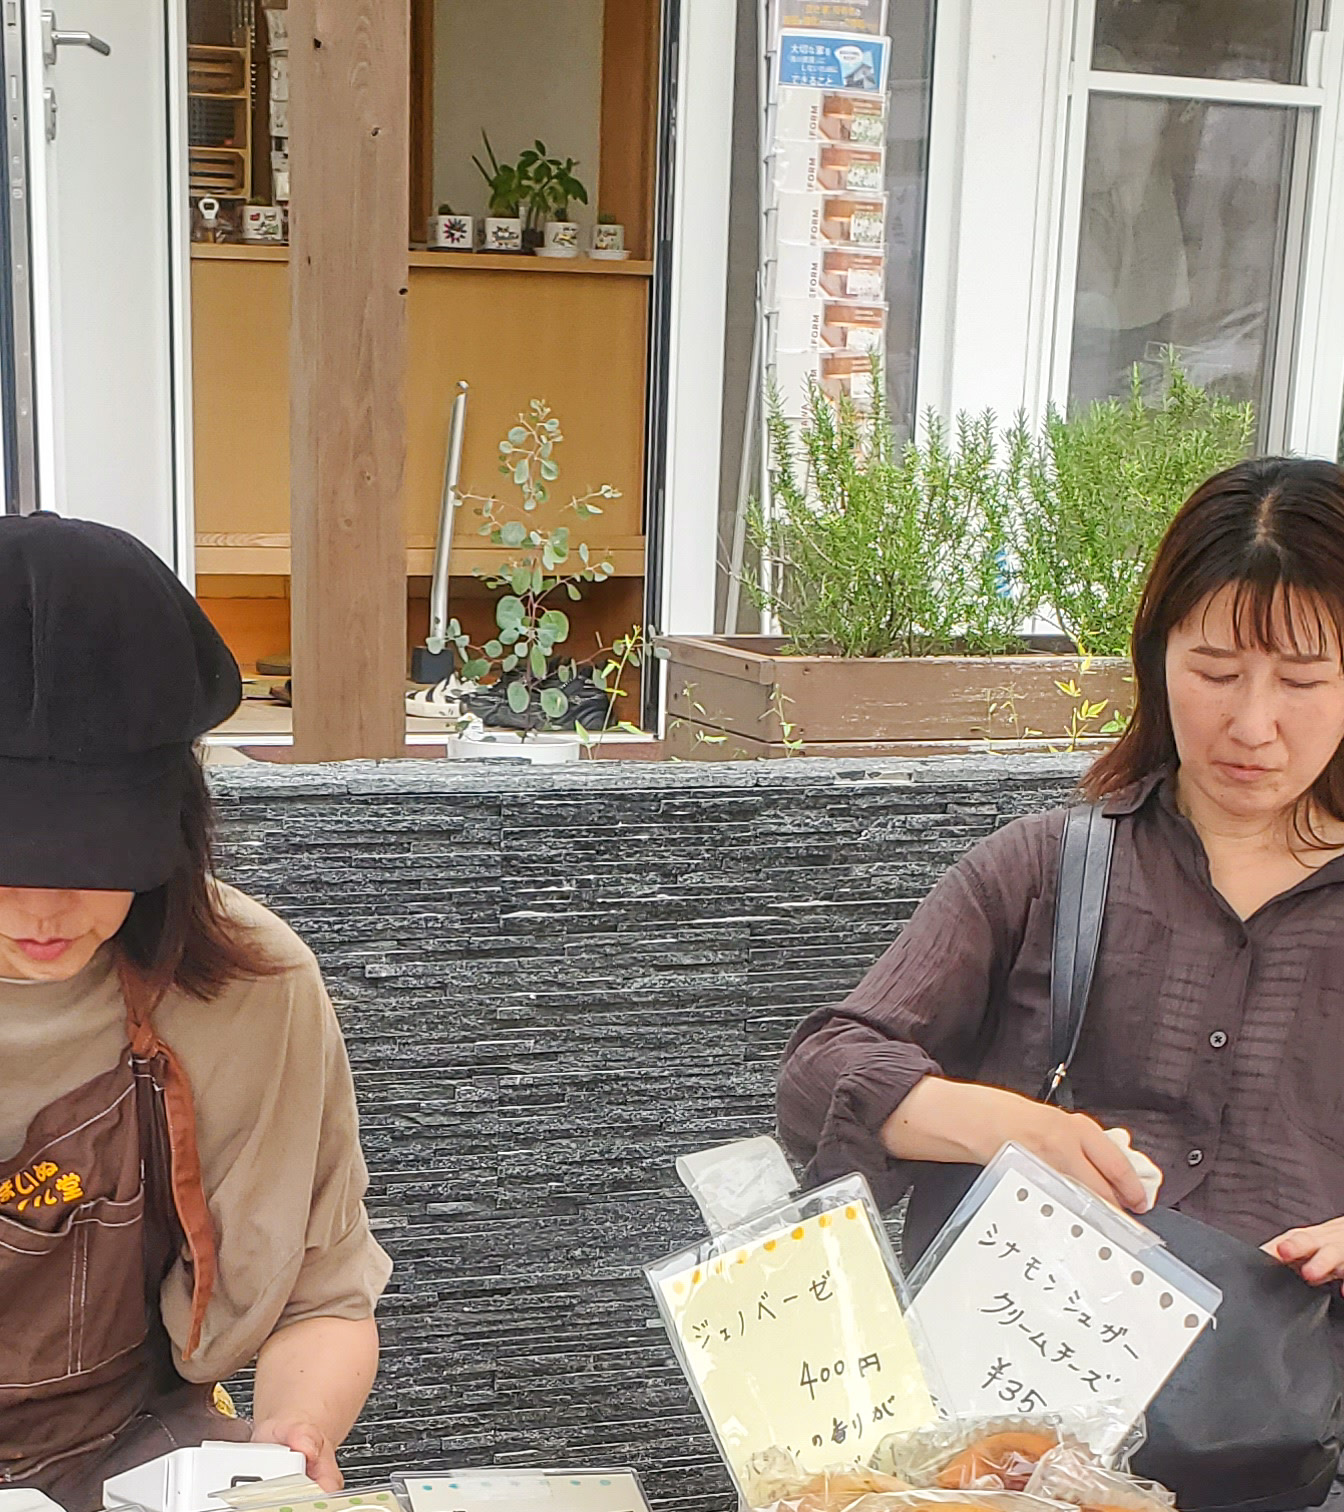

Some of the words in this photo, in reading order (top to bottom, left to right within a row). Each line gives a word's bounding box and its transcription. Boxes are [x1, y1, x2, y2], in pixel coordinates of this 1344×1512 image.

[808, 105, 818, 140] FORM
[807, 157, 817, 192] FORM
[810, 314, 819, 347] FORM
[692, 1270, 834, 1349] ジェノベーゼ
[978, 1223, 1140, 1360] シナモンシュガー
[978, 1292, 1120, 1393] クリームチーズ
[800, 1353, 881, 1400] 400円
[787, 1395, 895, 1457] の香りが
